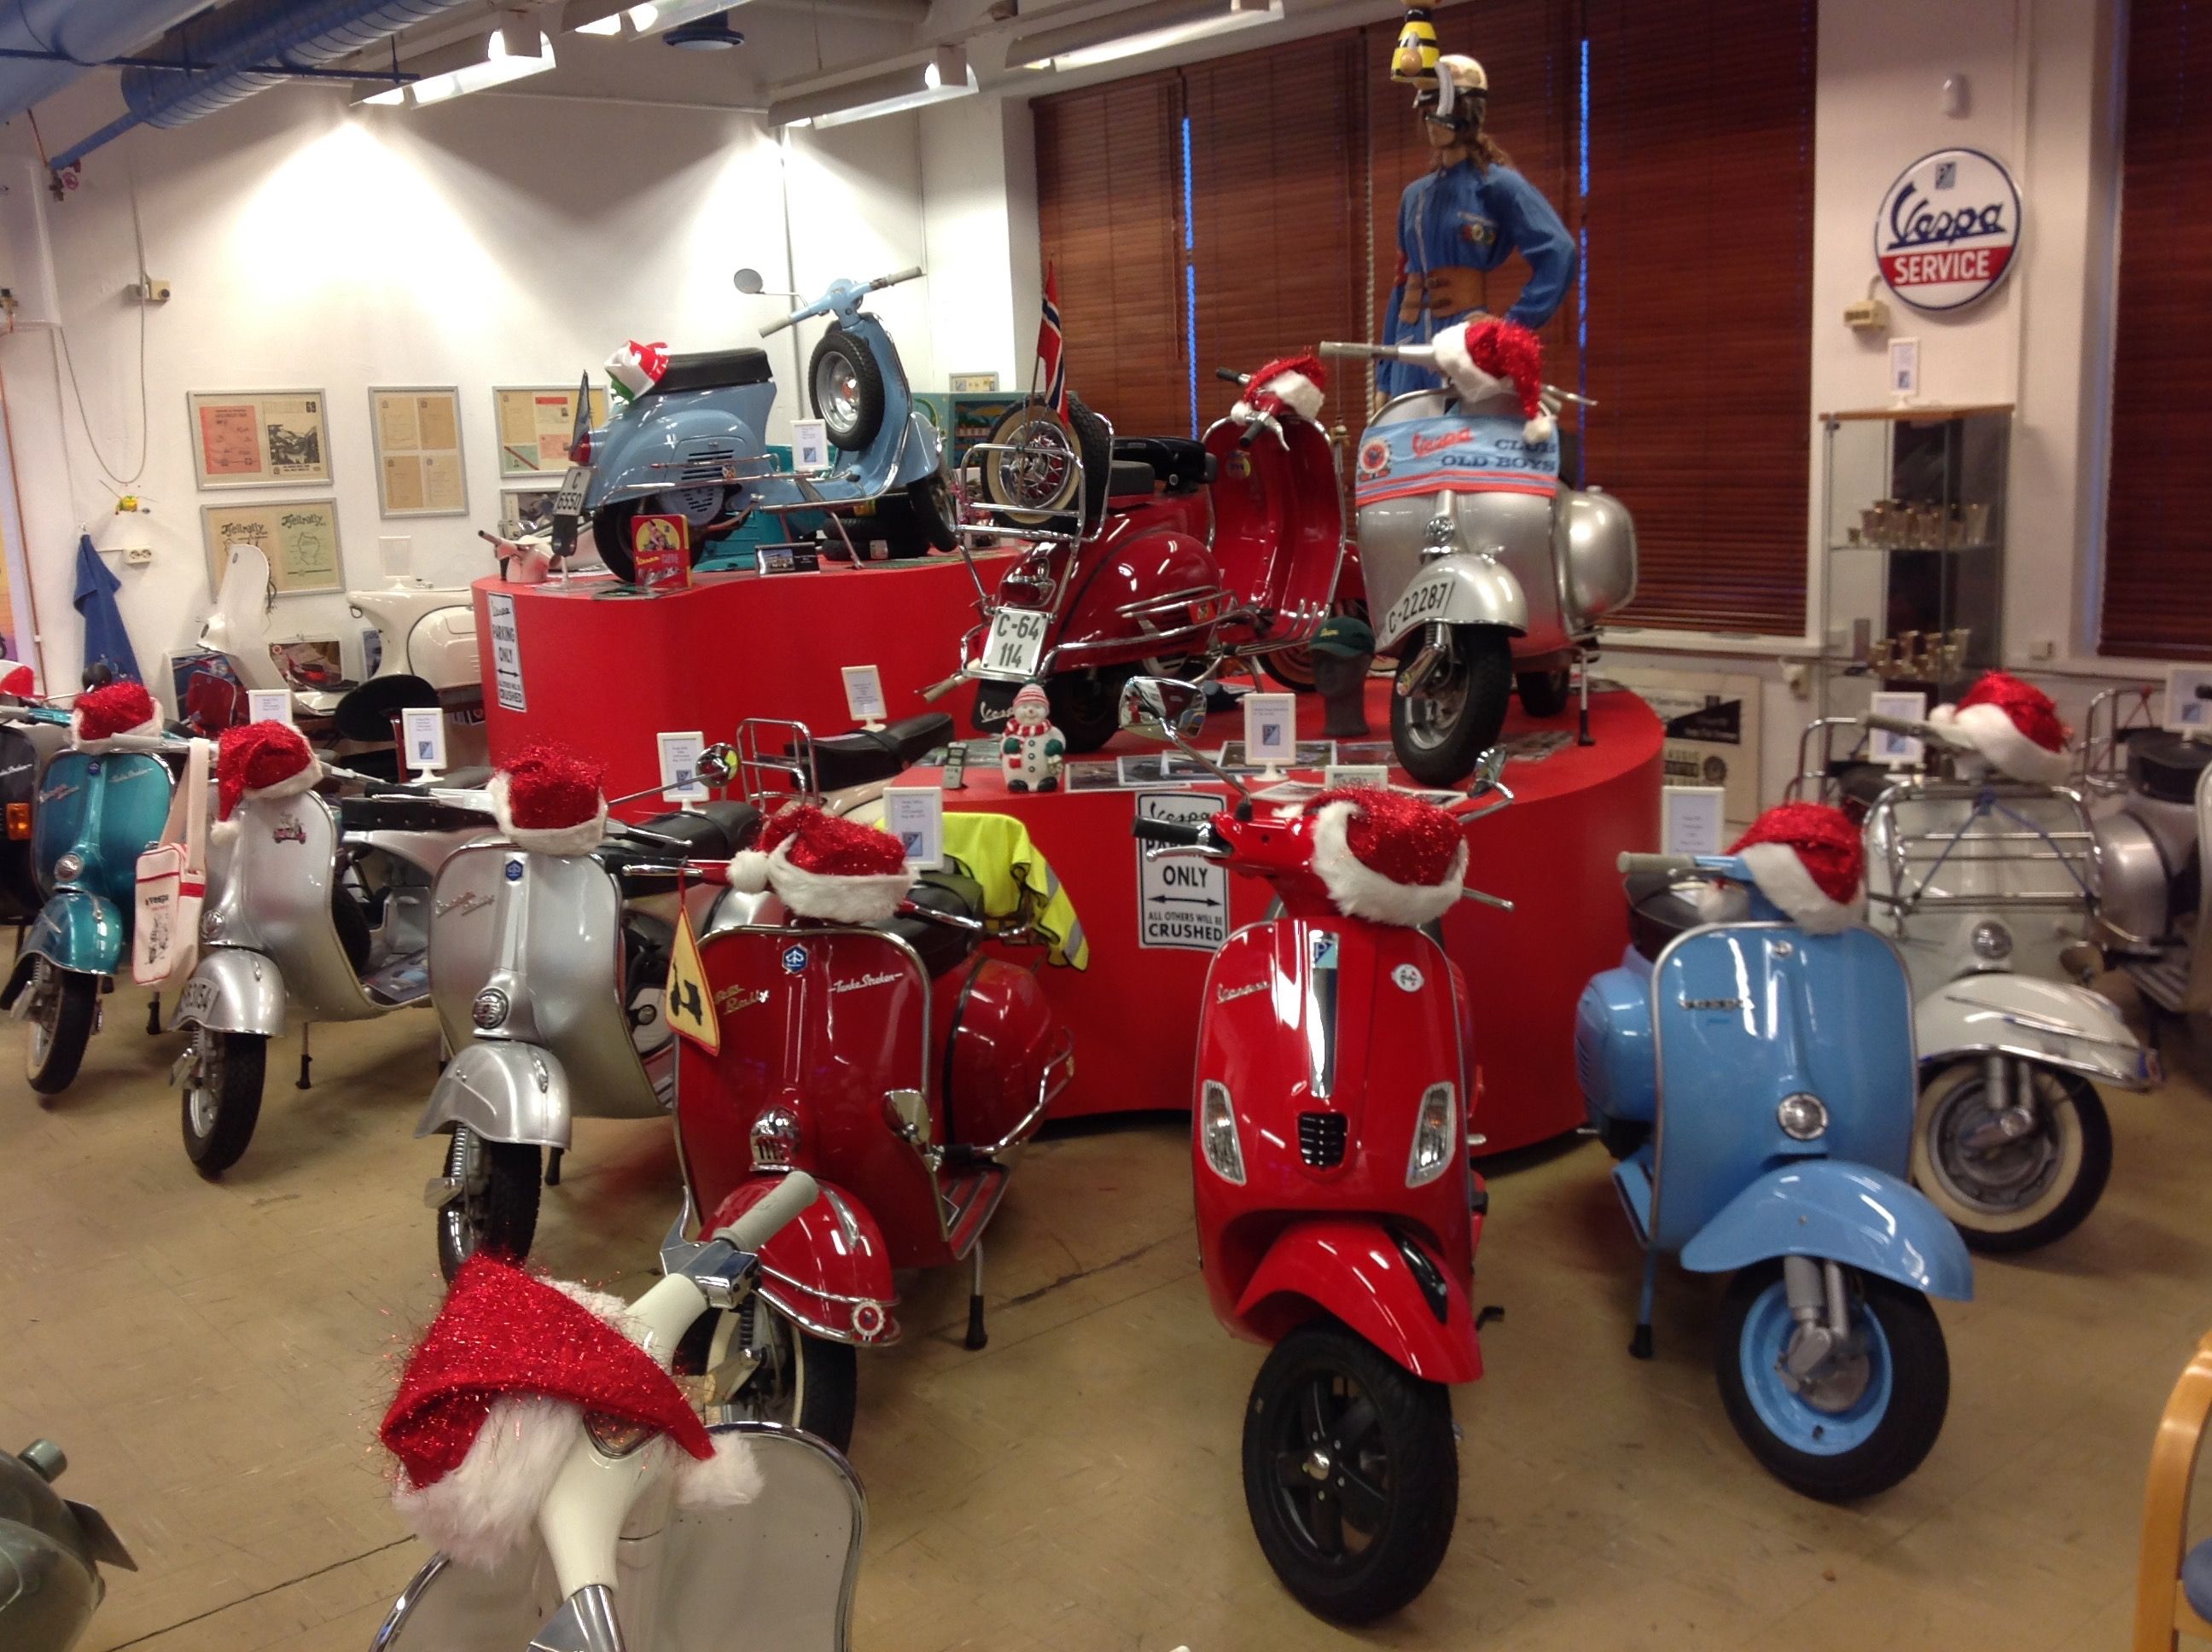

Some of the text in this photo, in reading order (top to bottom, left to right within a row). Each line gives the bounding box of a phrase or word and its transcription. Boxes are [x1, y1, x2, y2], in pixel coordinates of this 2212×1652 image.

[1887, 181, 2006, 251] Vespa
[1894, 251, 1990, 284] SERVICE
[1441, 455, 1555, 471] OLD BOYS
[573, 471, 581, 490] C
[556, 492, 583, 510] 6550
[1389, 583, 1447, 634] C-22287
[997, 614, 1039, 640] C-64
[998, 643, 1022, 667] 114
[1163, 865, 1208, 887] ONLY
[1149, 911, 1222, 925] ALL OTHERS WILL BE
[1149, 923, 1223, 941] CRUSHED
